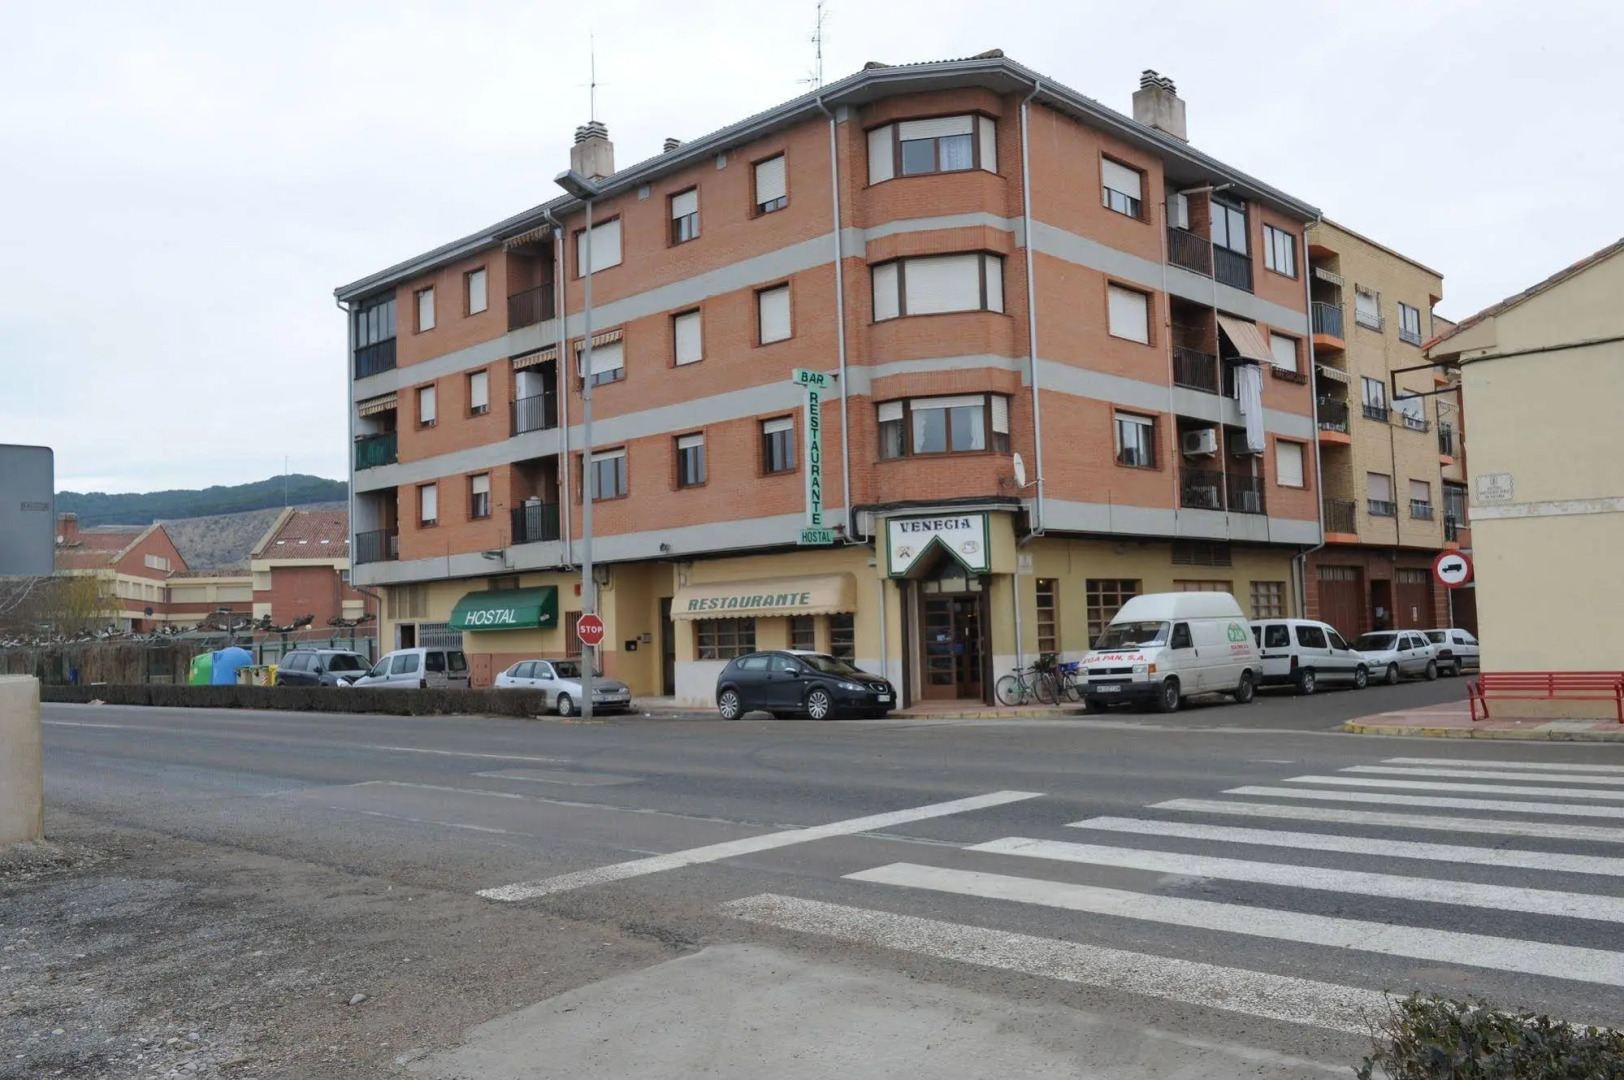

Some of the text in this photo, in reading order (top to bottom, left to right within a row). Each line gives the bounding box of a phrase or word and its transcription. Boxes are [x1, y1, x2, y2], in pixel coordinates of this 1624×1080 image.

[801, 371, 824, 385] BAR
[809, 391, 821, 525] RESTAURANTE
[801, 531, 832, 543] HOSTAL
[688, 592, 811, 611] RESTAURANTE
[464, 608, 517, 625] HOSTAL
[580, 625, 603, 634] STOP
